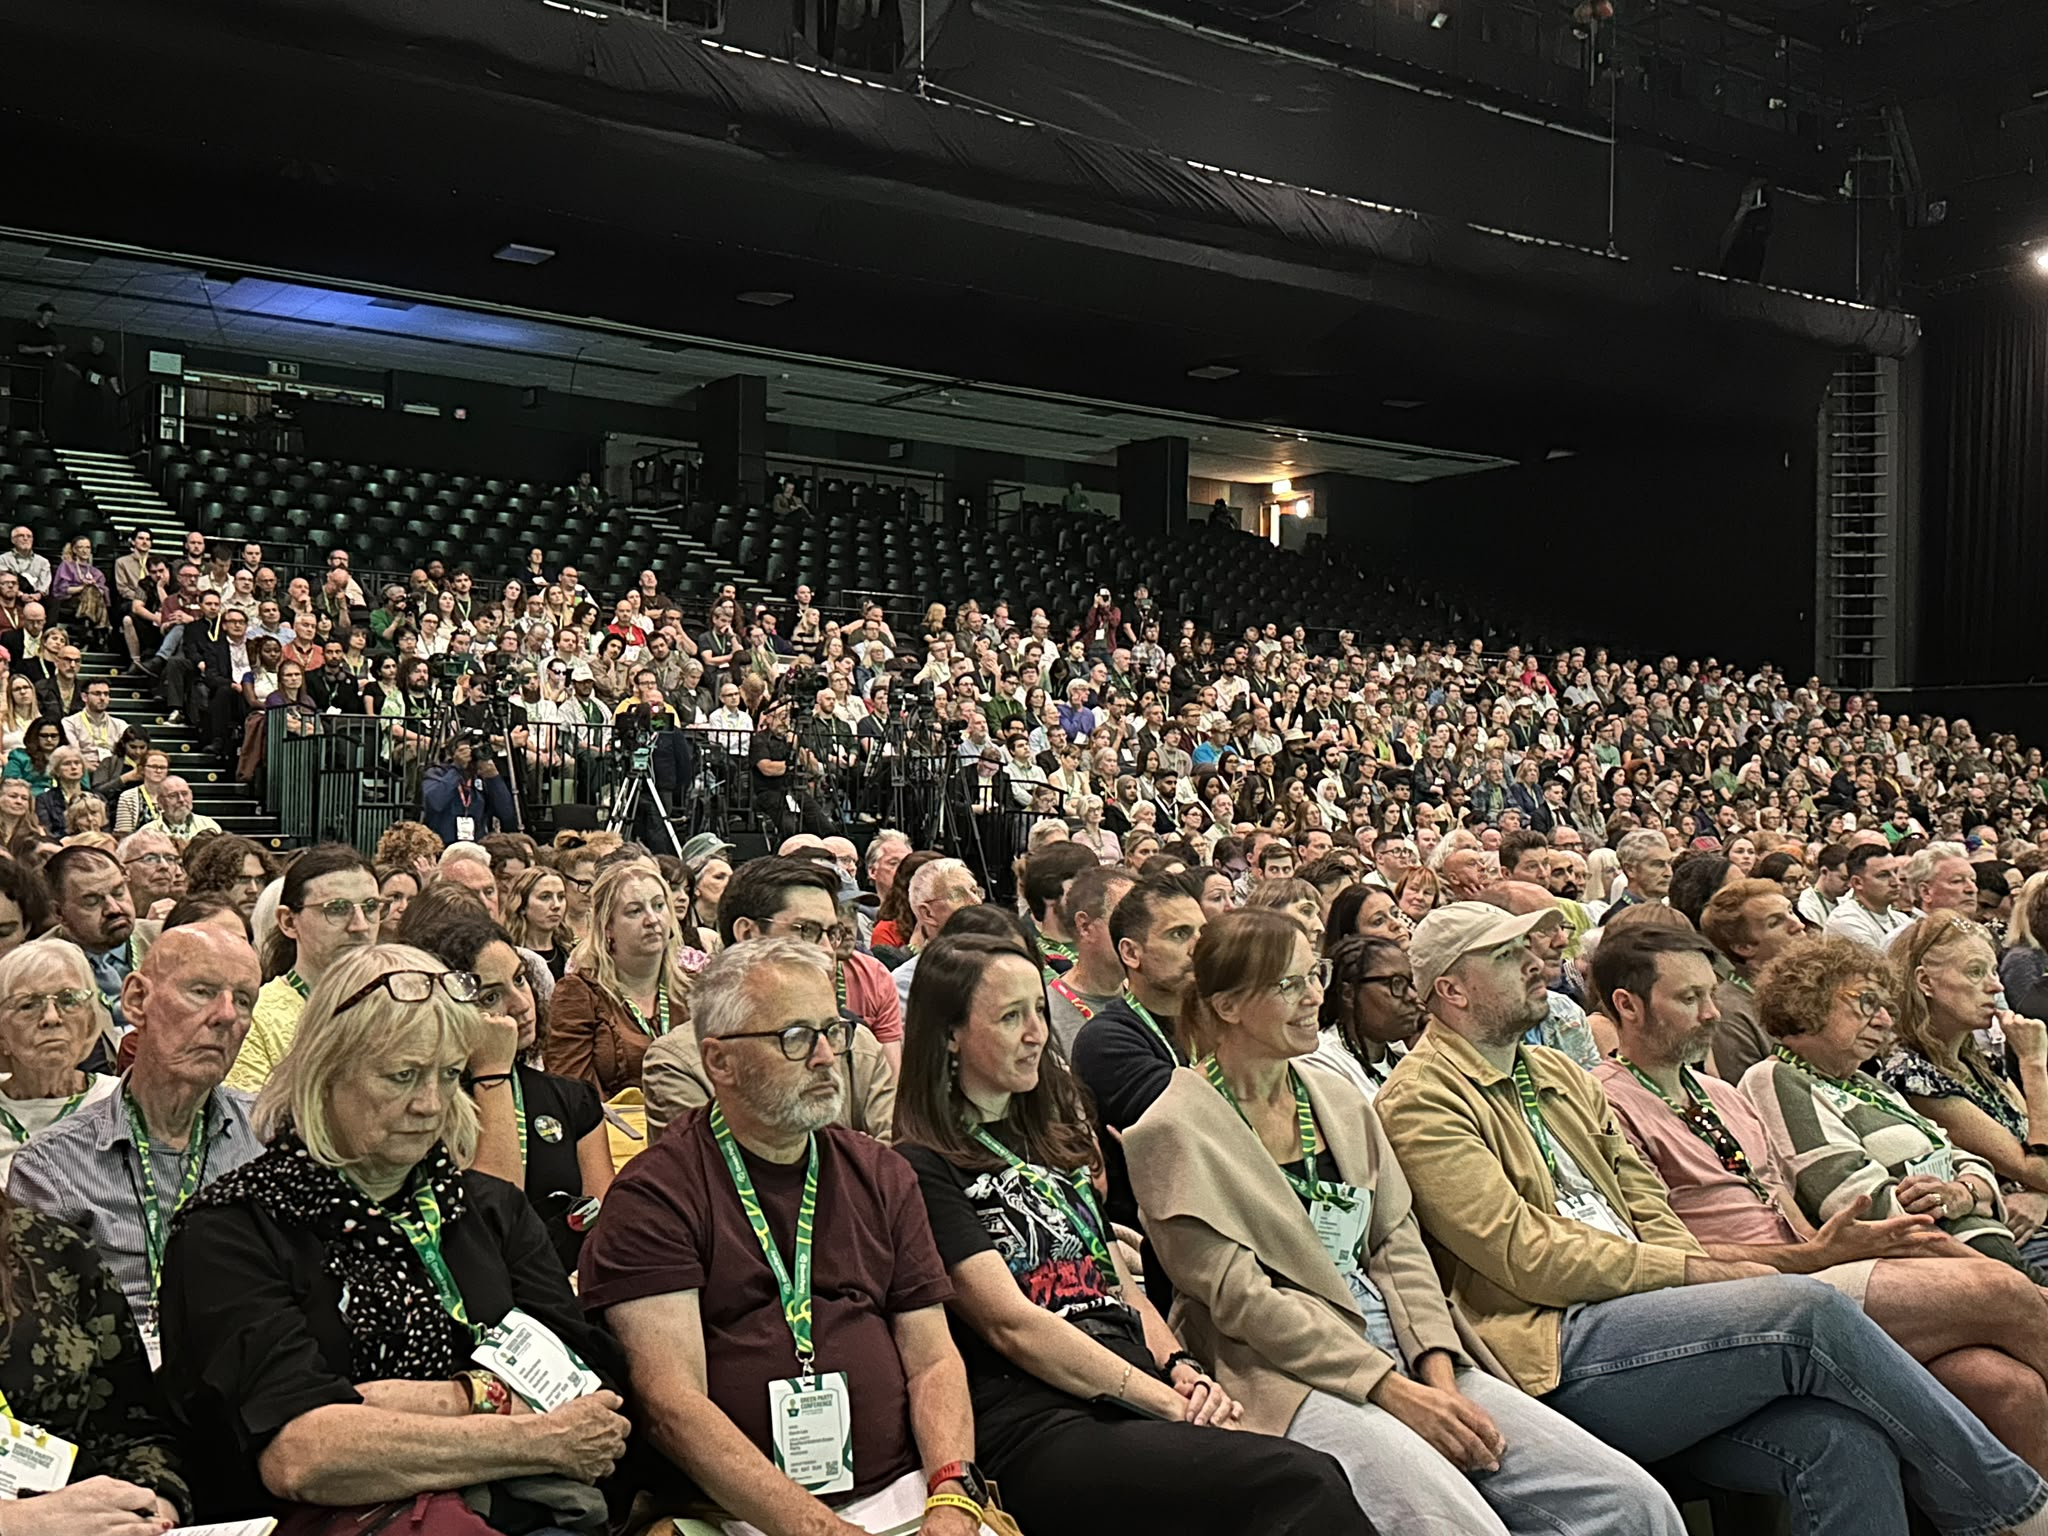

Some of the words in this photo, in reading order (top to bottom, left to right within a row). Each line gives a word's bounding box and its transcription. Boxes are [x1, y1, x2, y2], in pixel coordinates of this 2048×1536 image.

[725, 1141, 735, 1157] Party
[731, 1155, 742, 1173] Green
[770, 1250, 780, 1266] Party
[431, 1261, 444, 1281] Green
[440, 1280, 451, 1299] Party
[777, 1265, 787, 1283] Green
[800, 1401, 833, 1409] CONFERENCE
